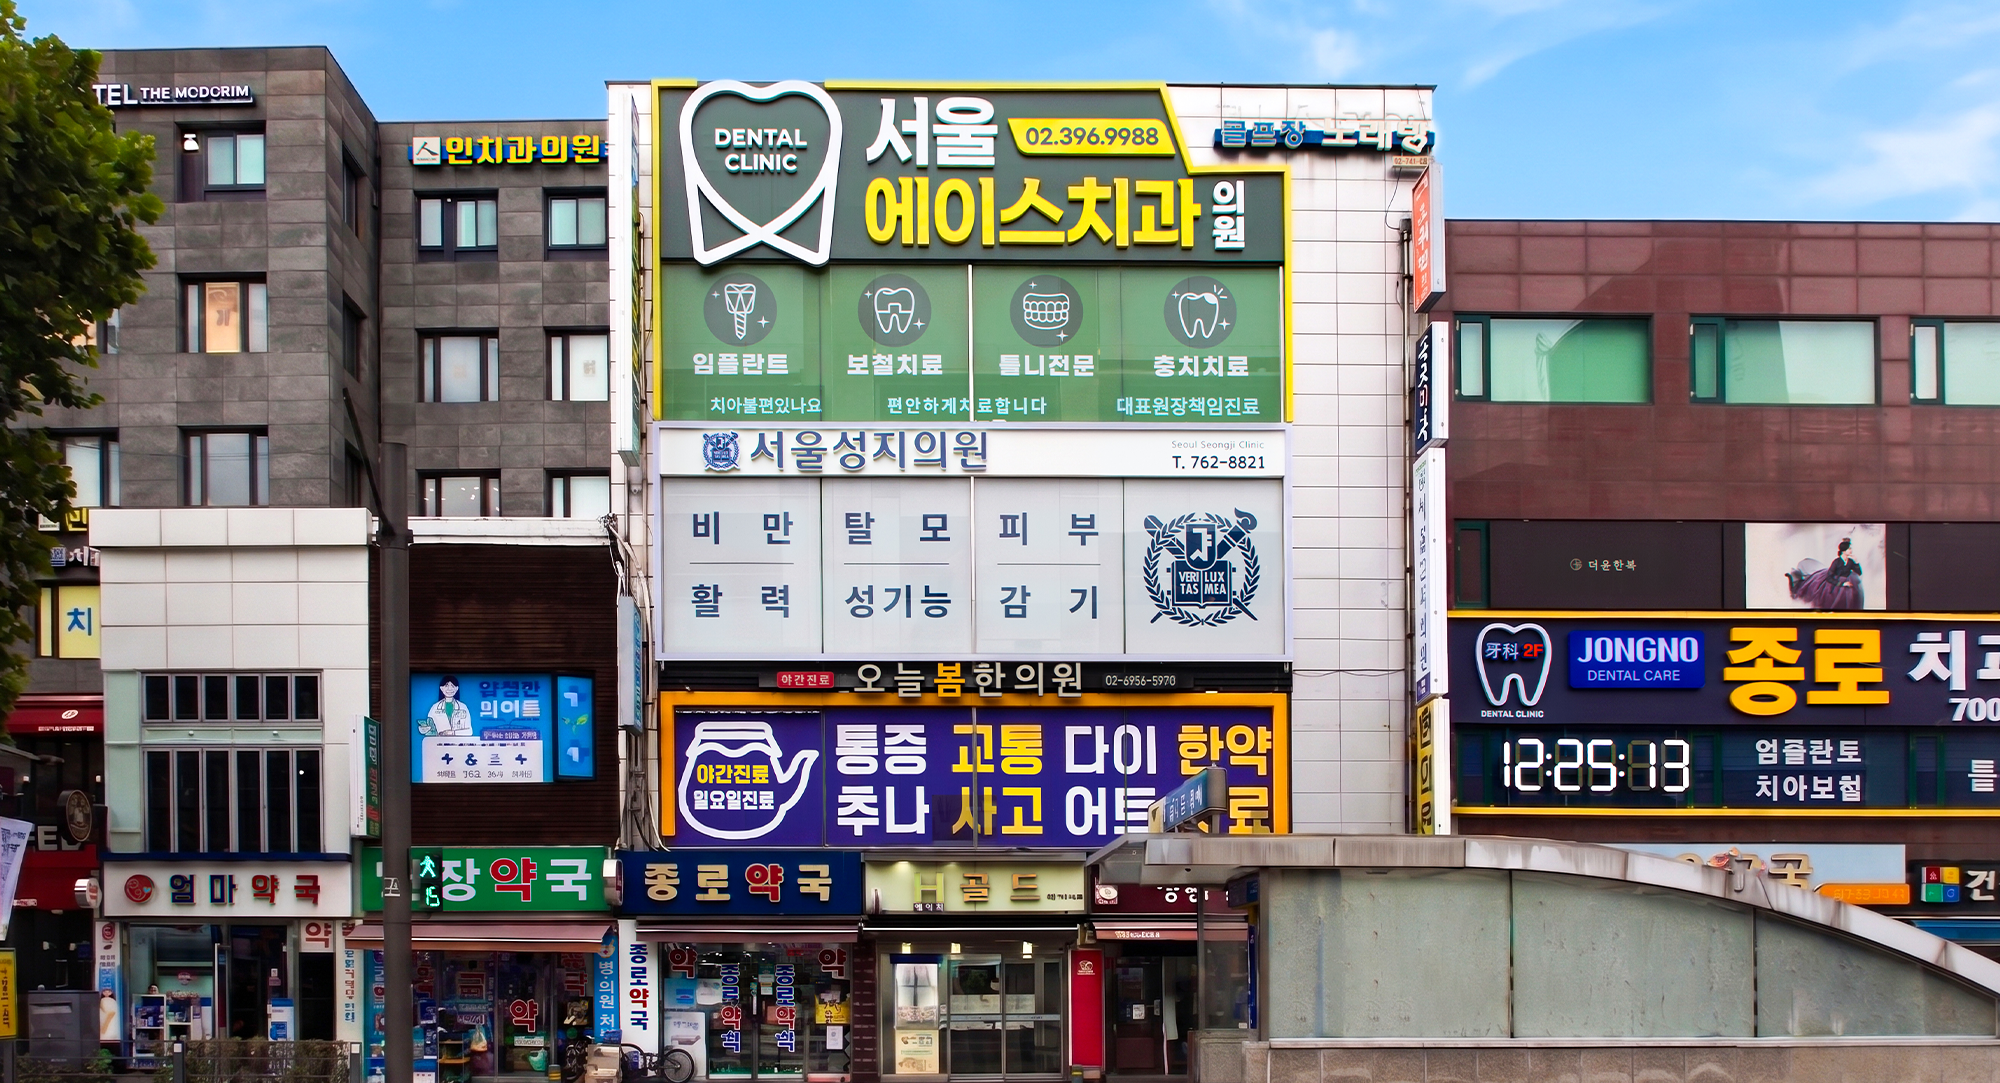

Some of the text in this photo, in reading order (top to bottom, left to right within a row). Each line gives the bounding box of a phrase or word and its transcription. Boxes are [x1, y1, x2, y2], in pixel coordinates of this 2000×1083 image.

[140, 87, 170, 99] THE
[715, 128, 808, 149] DENTAL
[866, 97, 998, 168] 서울
[1025, 127, 1159, 146] 02.396.9988
[446, 135, 599, 165] 인치과의원
[725, 153, 798, 173] CLINIC
[865, 175, 1201, 249] 에이스치과
[1212, 180, 1245, 250] 의원
[692, 353, 789, 376] 임플란트
[847, 354, 943, 375] 보철치료
[999, 354, 1095, 377] 틀니전문
[1153, 354, 1249, 377] 충치치료
[710, 397, 822, 415] 치아불편있나요
[1117, 397, 1260, 416] 대표원장책임진료
[750, 430, 988, 472] 서울성지의원
[1171, 440, 1265, 451] Seoul Seongji Clinic
[1172, 456, 1265, 469] T. 762-8821
[1179, 571, 1199, 582] VERI
[1205, 571, 1225, 582] LUX
[1588, 559, 1637, 571] 더윤한복
[1181, 584, 1199, 594] TAS
[1205, 584, 1226, 594] MEA
[845, 585, 952, 618] 성기능
[66, 608, 92, 636] 치
[1485, 643, 1519, 660] 牙科
[1523, 643, 1543, 657] 2F
[1577, 637, 1699, 662] JONGNO
[781, 674, 830, 686] 야간진료
[1588, 670, 1680, 681] DENTAL CARE
[1724, 627, 1890, 716] 종로
[835, 725, 1272, 775] 통증 교통 다이 한약
[696, 764, 769, 784] 야간진료
[1503, 739, 1690, 792] 12:25:13
[693, 790, 775, 810] 일요일진료
[837, 786, 929, 836] 추나
[952, 786, 1043, 836] 사고
[170, 874, 321, 905] 엄마약국
[376, 857, 592, 902] 장약국
[644, 863, 832, 902] 종로약국
[1965, 870, 1995, 900] 건
[914, 903, 944, 912] 에이치
[305, 922, 332, 948] 약
[669, 949, 697, 979] 약
[818, 949, 847, 978] 약
[629, 944, 649, 1030] 종로약국
[510, 999, 539, 1033] 약
